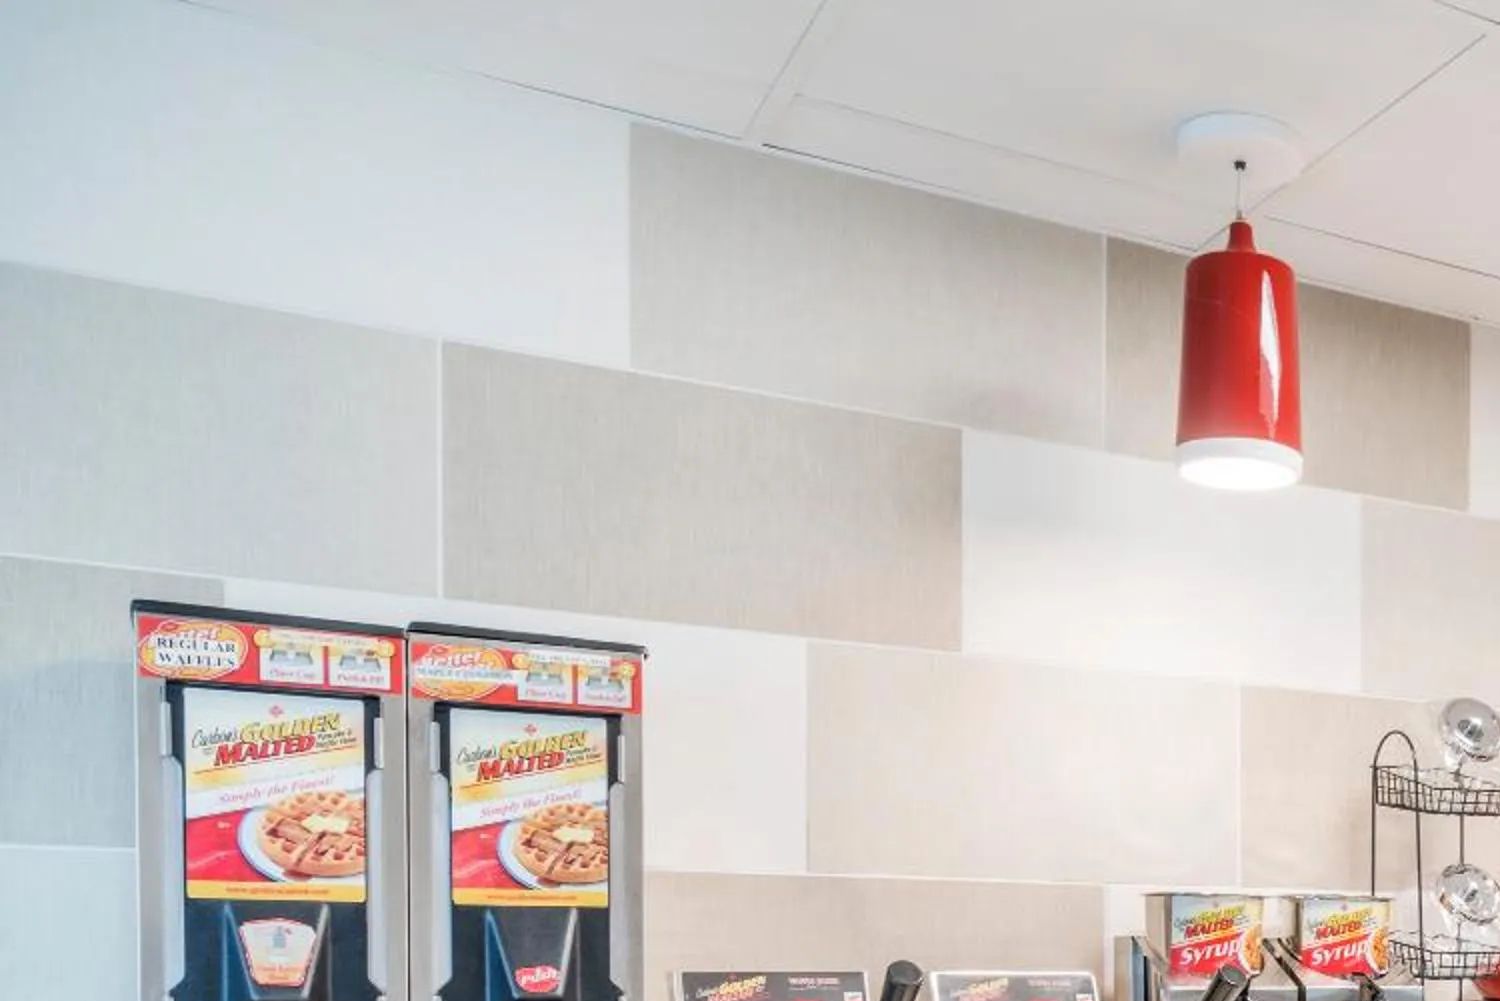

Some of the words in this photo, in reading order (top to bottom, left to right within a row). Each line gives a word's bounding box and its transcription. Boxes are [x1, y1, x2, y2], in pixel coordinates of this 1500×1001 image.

[156, 636, 236, 653] REGULAR
[158, 651, 236, 668] WAFFLES
[239, 711, 341, 744] GOLDEN
[213, 735, 317, 766] MALTED
[476, 751, 566, 782] MALTED
[267, 782, 287, 795] the
